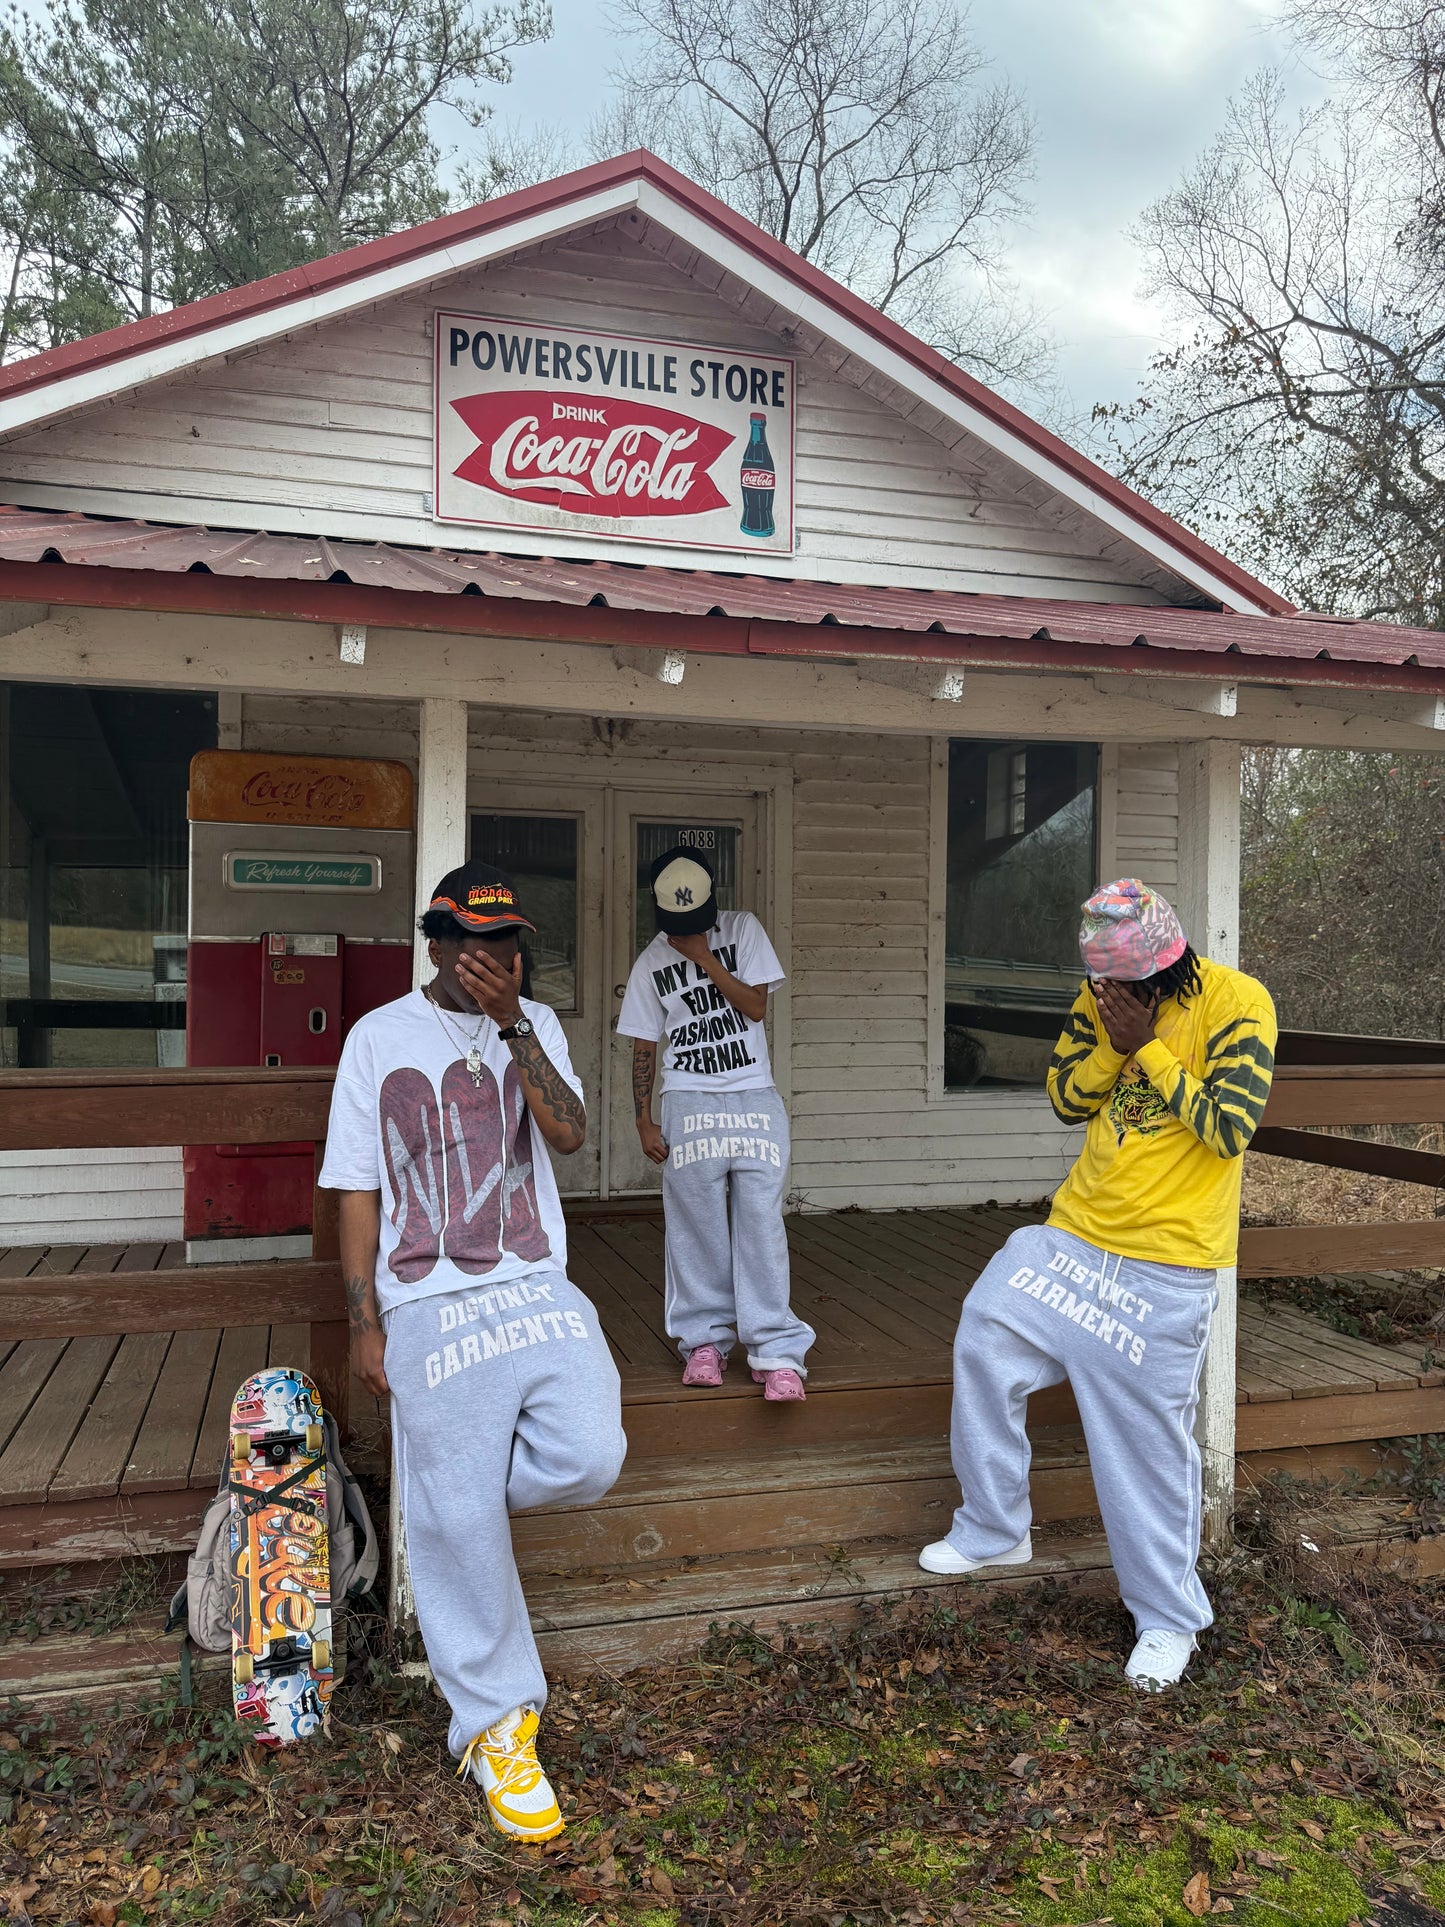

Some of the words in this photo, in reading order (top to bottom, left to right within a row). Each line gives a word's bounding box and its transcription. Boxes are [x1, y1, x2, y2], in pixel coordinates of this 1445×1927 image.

[450, 327, 678, 395] POWERSVILLE
[689, 359, 786, 408] STORE
[552, 401, 609, 426] DRINK
[679, 830, 714, 848] 6088
[246, 862, 301, 882] Refresh
[304, 863, 363, 884] Yourself
[468, 896, 497, 906] GRAND
[497, 896, 514, 905] PRIX
[674, 886, 694, 907] NY
[652, 960, 689, 998] MY
[680, 983, 726, 1017] FOR
[683, 1112, 771, 1135] DISTINCT
[672, 1136, 781, 1170] GARMENTS
[1046, 1250, 1154, 1323] DISTINCT
[438, 1282, 556, 1334] DISTINCT
[1007, 1265, 1147, 1367] GARMENTS
[425, 1310, 589, 1390] GARMENTS
